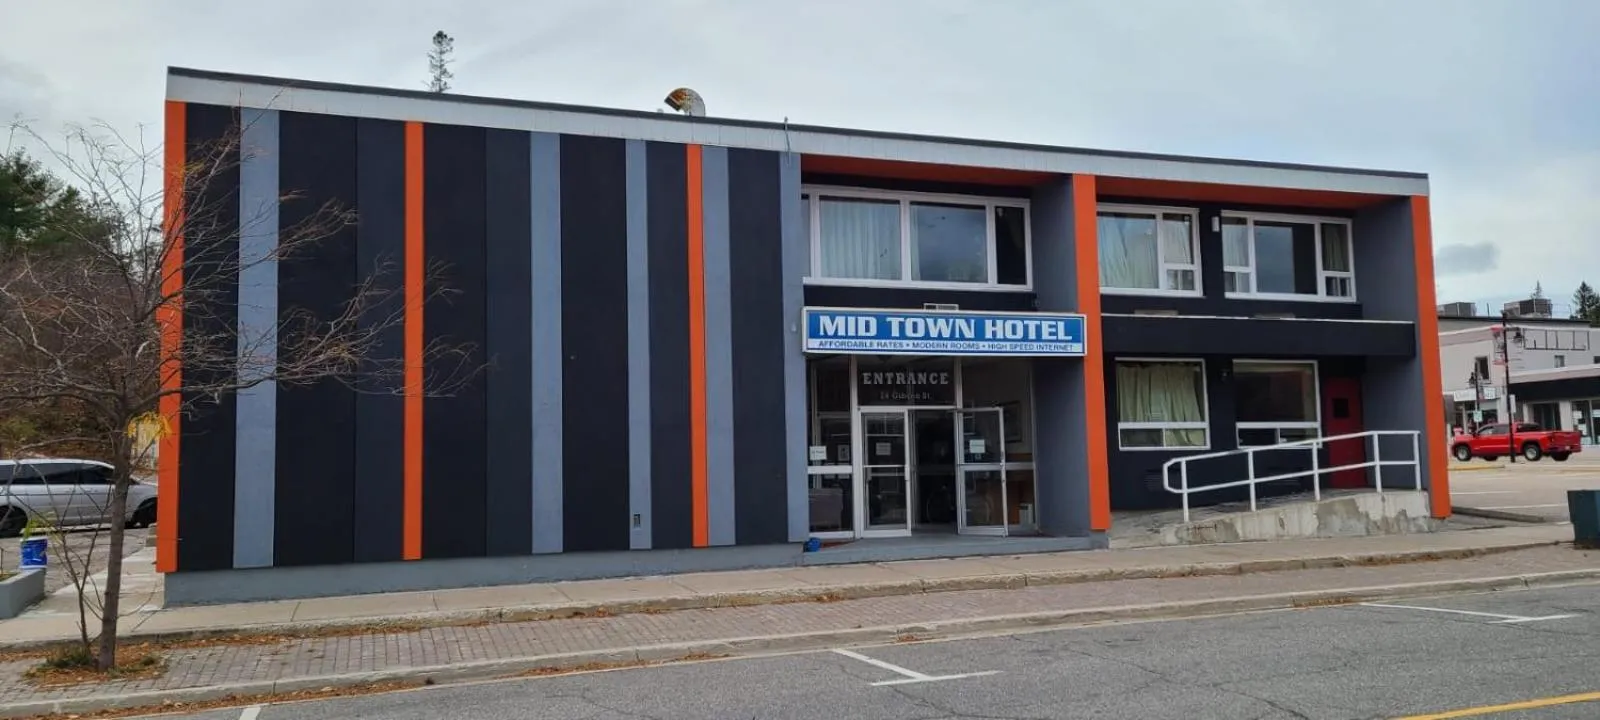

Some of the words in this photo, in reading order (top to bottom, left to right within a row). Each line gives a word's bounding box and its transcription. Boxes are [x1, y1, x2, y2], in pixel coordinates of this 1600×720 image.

[819, 315, 877, 336] MID
[886, 317, 975, 338] TOWN
[984, 319, 1073, 340] HOTEL
[818, 340, 873, 348] AFFORDABLE
[876, 341, 905, 349] RATES
[911, 341, 948, 349] MODERN
[950, 342, 980, 350] ROOMS
[988, 343, 1009, 351] HIGH
[1010, 343, 1034, 351] SPEED
[1036, 343, 1073, 352] INTERNET
[862, 371, 949, 384] ENTRANCE
